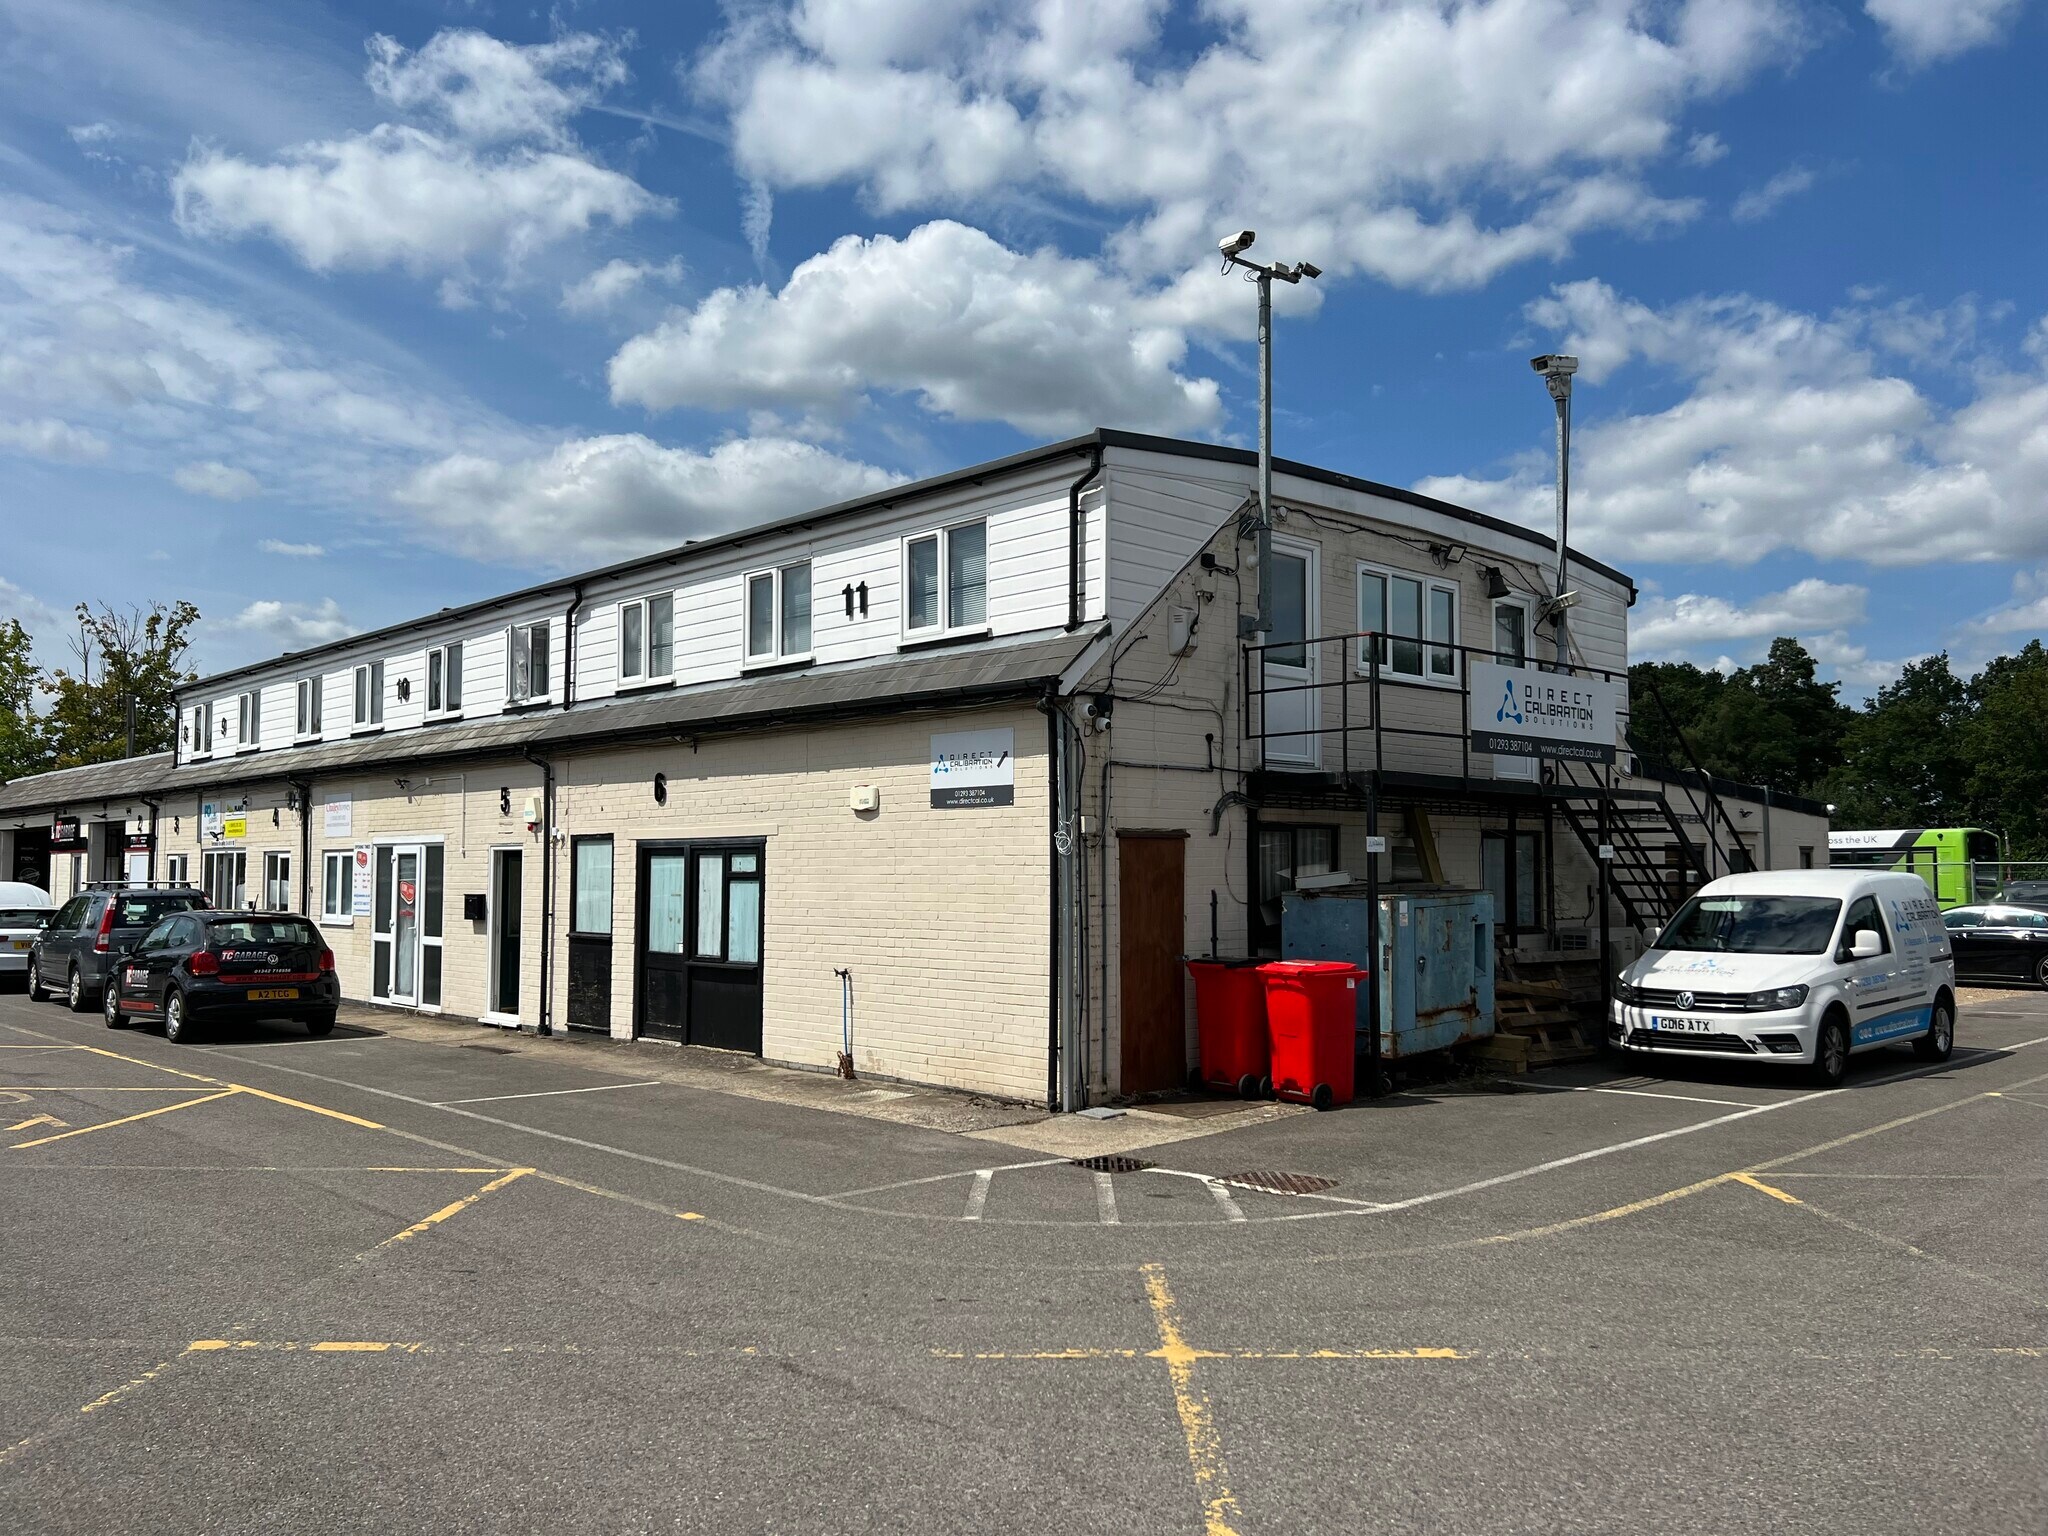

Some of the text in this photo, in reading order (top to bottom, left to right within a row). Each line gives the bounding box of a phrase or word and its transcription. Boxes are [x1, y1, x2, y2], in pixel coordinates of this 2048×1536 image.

[842, 581, 868, 616] 11
[397, 677, 411, 702] 10
[1525, 685, 1592, 706] DIRECT
[1525, 700, 1593, 721] CALIBRATION
[221, 717, 227, 736] 9
[1525, 715, 1593, 730] SOLUTIONS
[950, 751, 992, 760] DIRECT
[1489, 738, 1602, 758] 01293 387104 www.directcal.co.uk
[950, 759, 992, 767] CALIBRATION
[654, 773, 667, 802] 6
[501, 787, 510, 814] 5
[1845, 835, 1861, 843] the
[1863, 835, 1877, 843] UK
[1902, 899, 1935, 910] DIRECT
[222, 951, 268, 960] TC GARAGE
[272, 990, 289, 998] TCG
[1661, 1018, 1710, 1032] GD16 ATX
